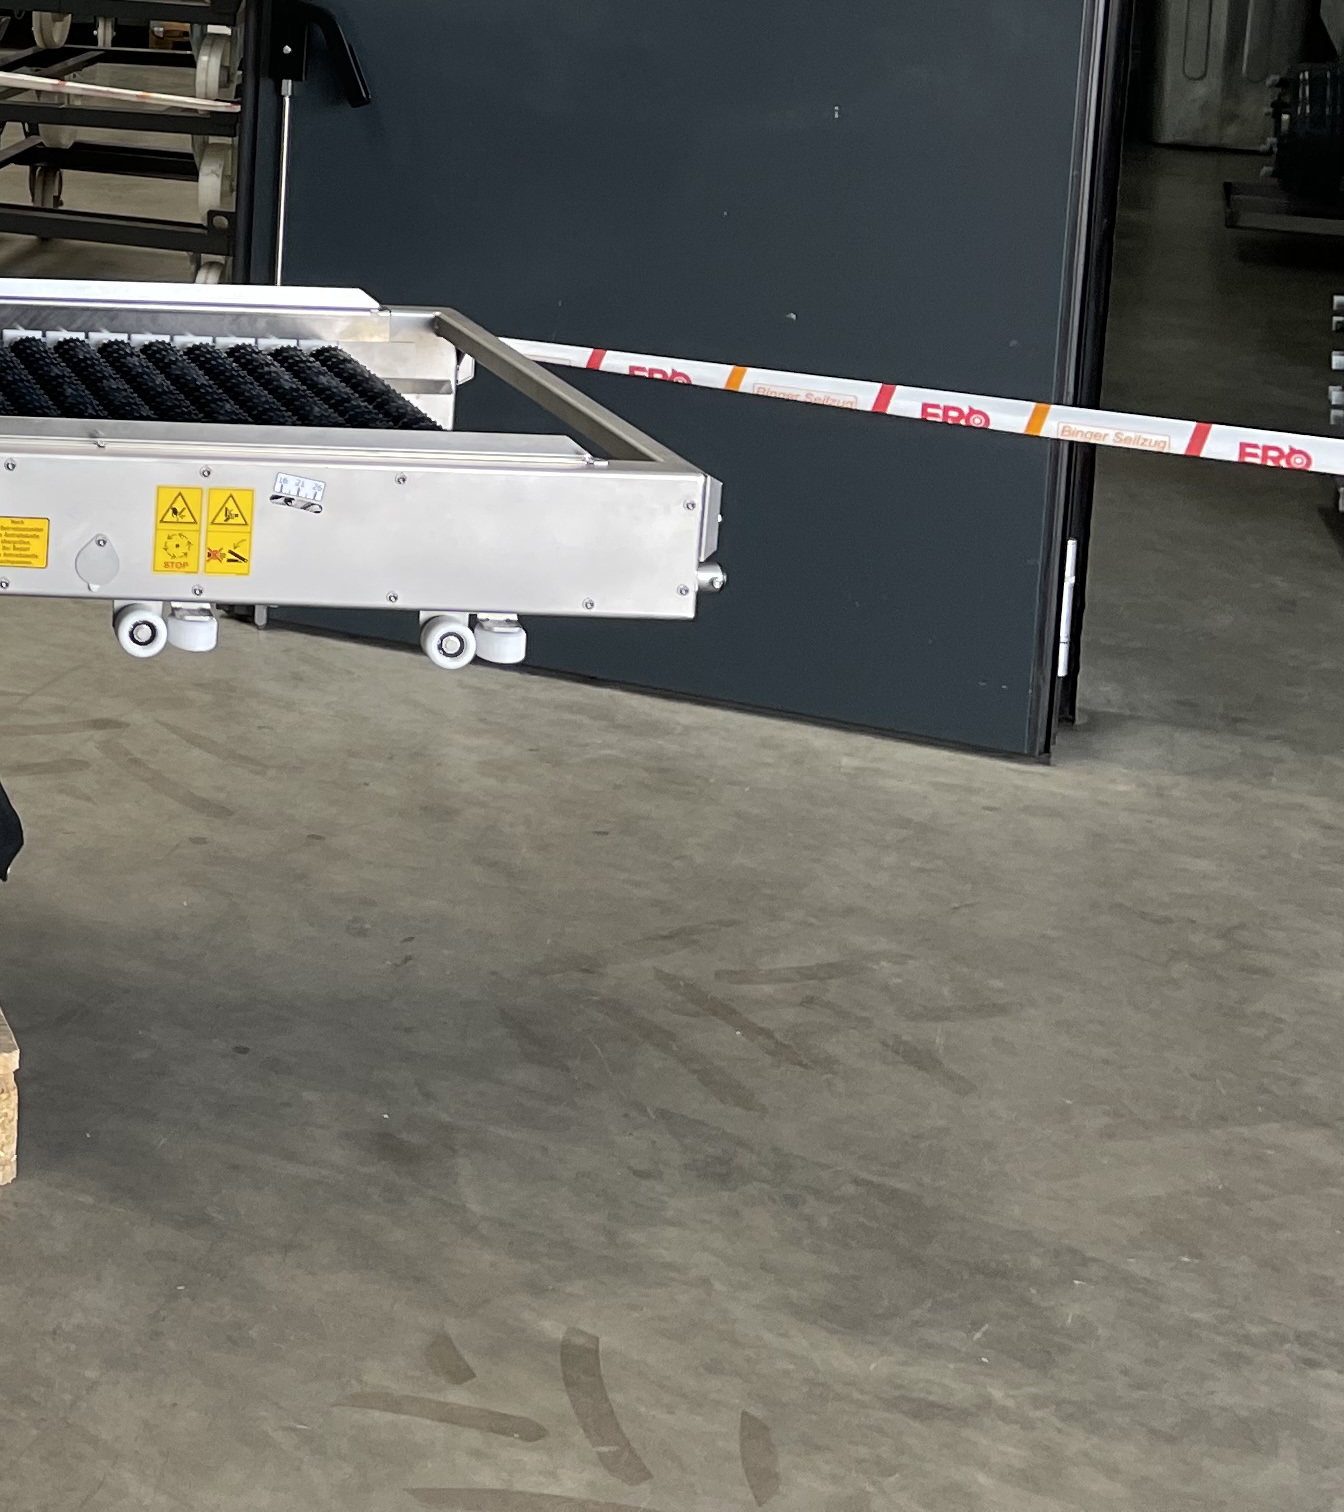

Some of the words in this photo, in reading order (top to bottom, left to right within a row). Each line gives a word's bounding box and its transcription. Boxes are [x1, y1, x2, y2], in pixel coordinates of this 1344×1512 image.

[1061, 424, 1109, 443] Binger
[1113, 431, 1168, 451] Seilzug
[294, 478, 306, 488] 21
[163, 561, 190, 570] STOP
